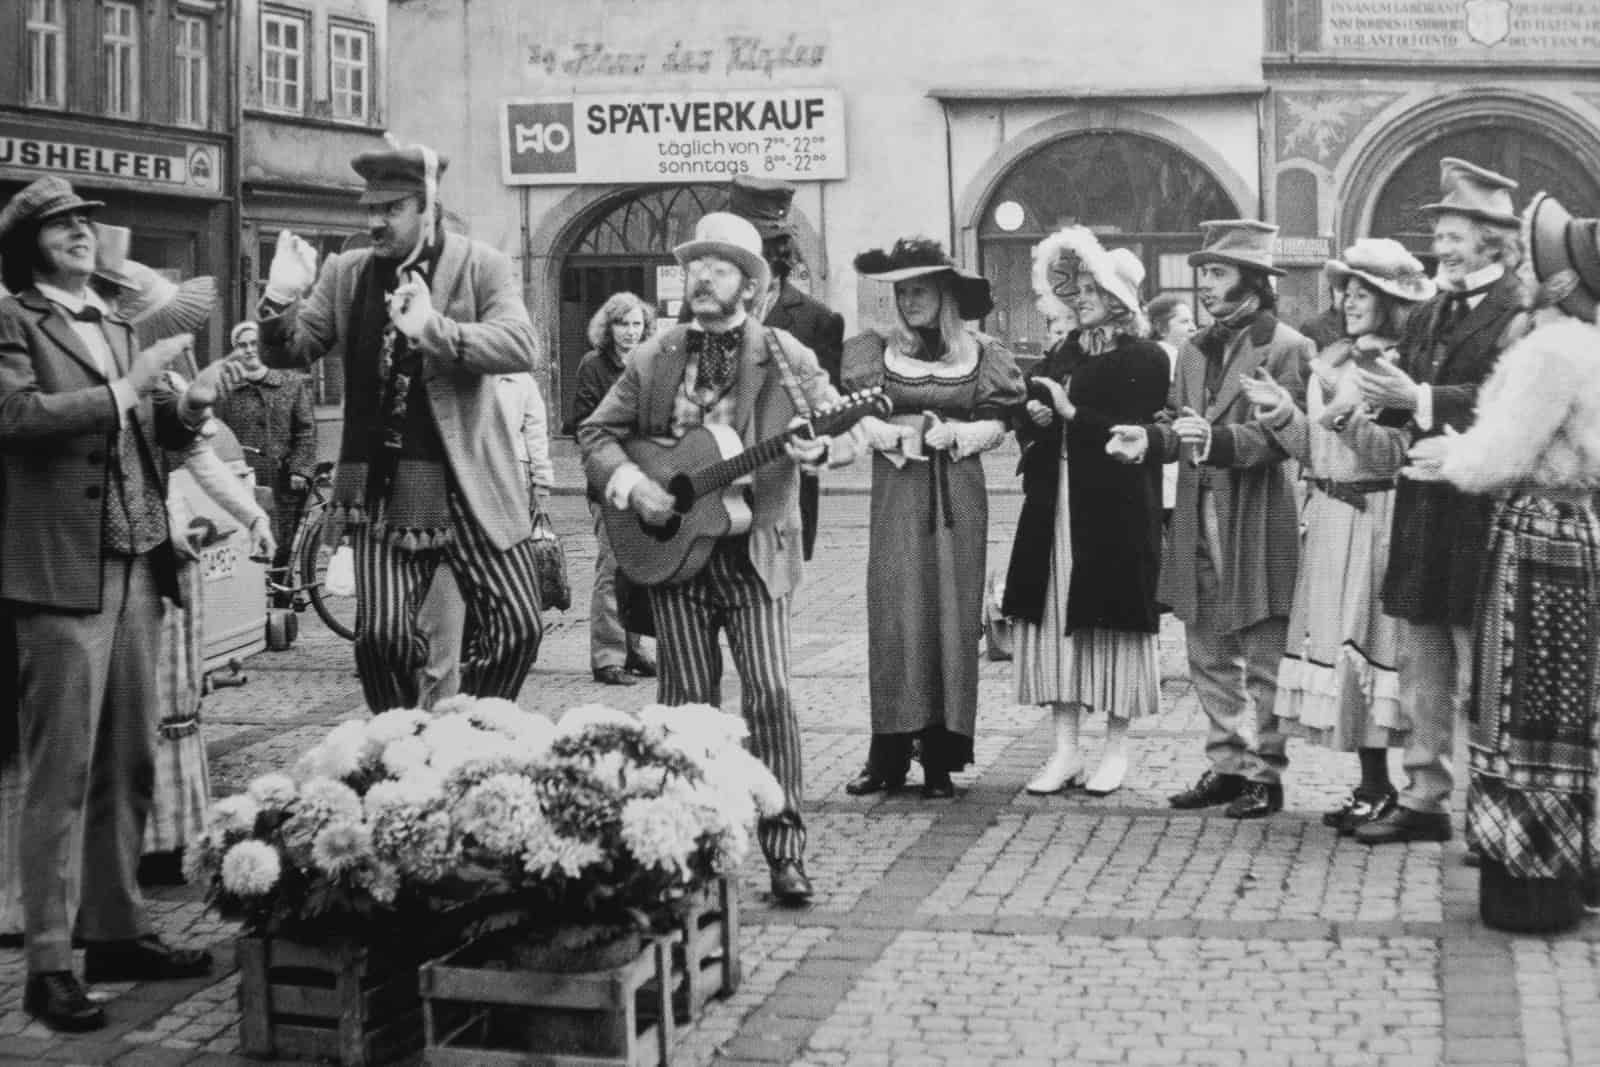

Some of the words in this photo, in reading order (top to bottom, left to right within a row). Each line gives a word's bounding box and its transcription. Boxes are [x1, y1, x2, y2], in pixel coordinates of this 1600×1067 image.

[658, 139, 725, 158] täglich
[728, 142, 760, 155] von
[658, 159, 750, 175] sonntags
